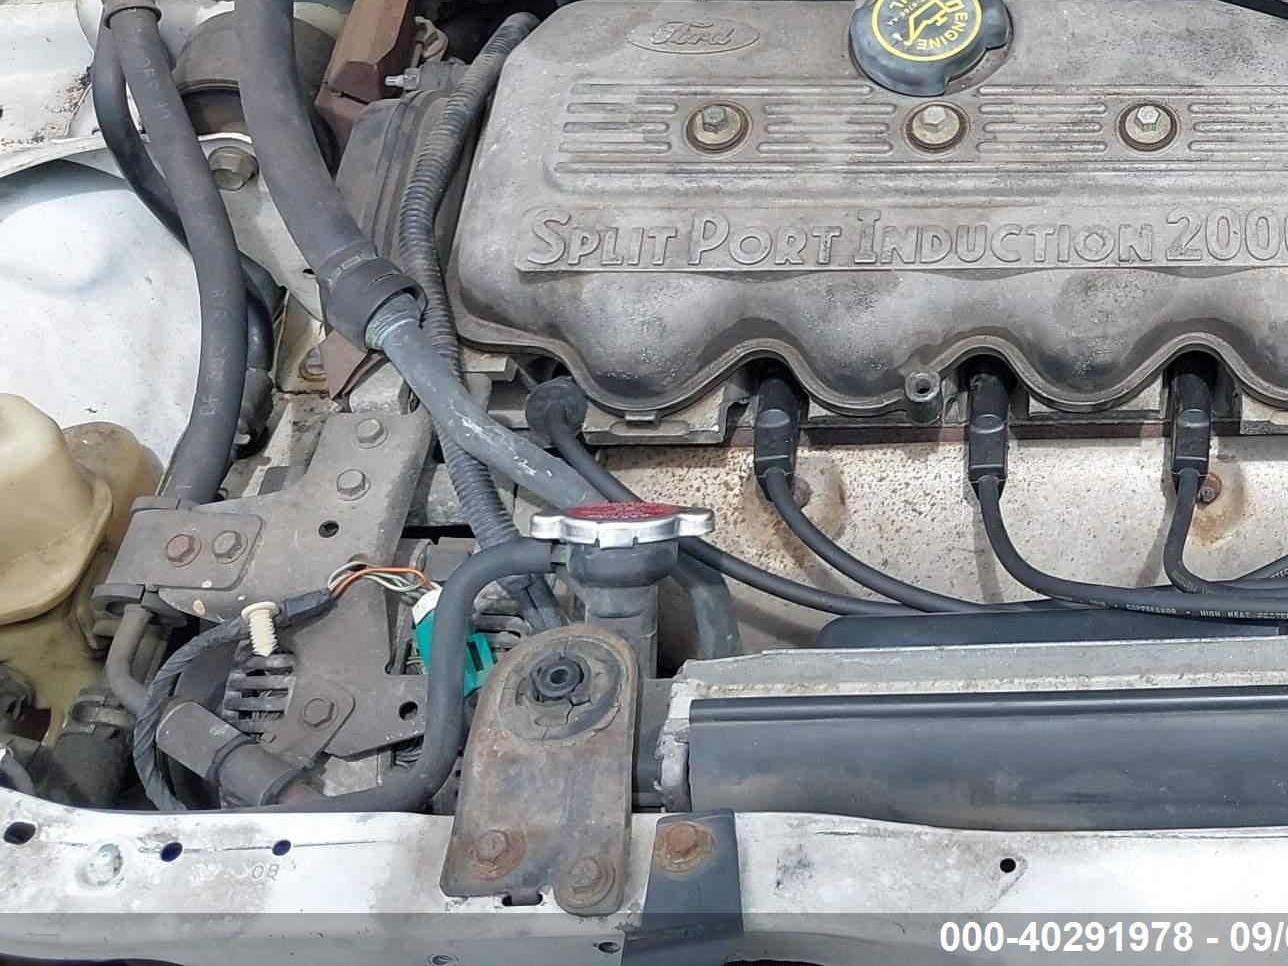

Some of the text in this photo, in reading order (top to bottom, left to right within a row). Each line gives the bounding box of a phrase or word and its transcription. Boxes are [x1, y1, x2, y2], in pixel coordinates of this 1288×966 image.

[649, 20, 737, 46] Ford
[917, 11, 969, 50] ENGINE
[525, 207, 679, 267] SPLIT
[687, 208, 845, 266] PORT
[853, 208, 1154, 266] INDUCTION
